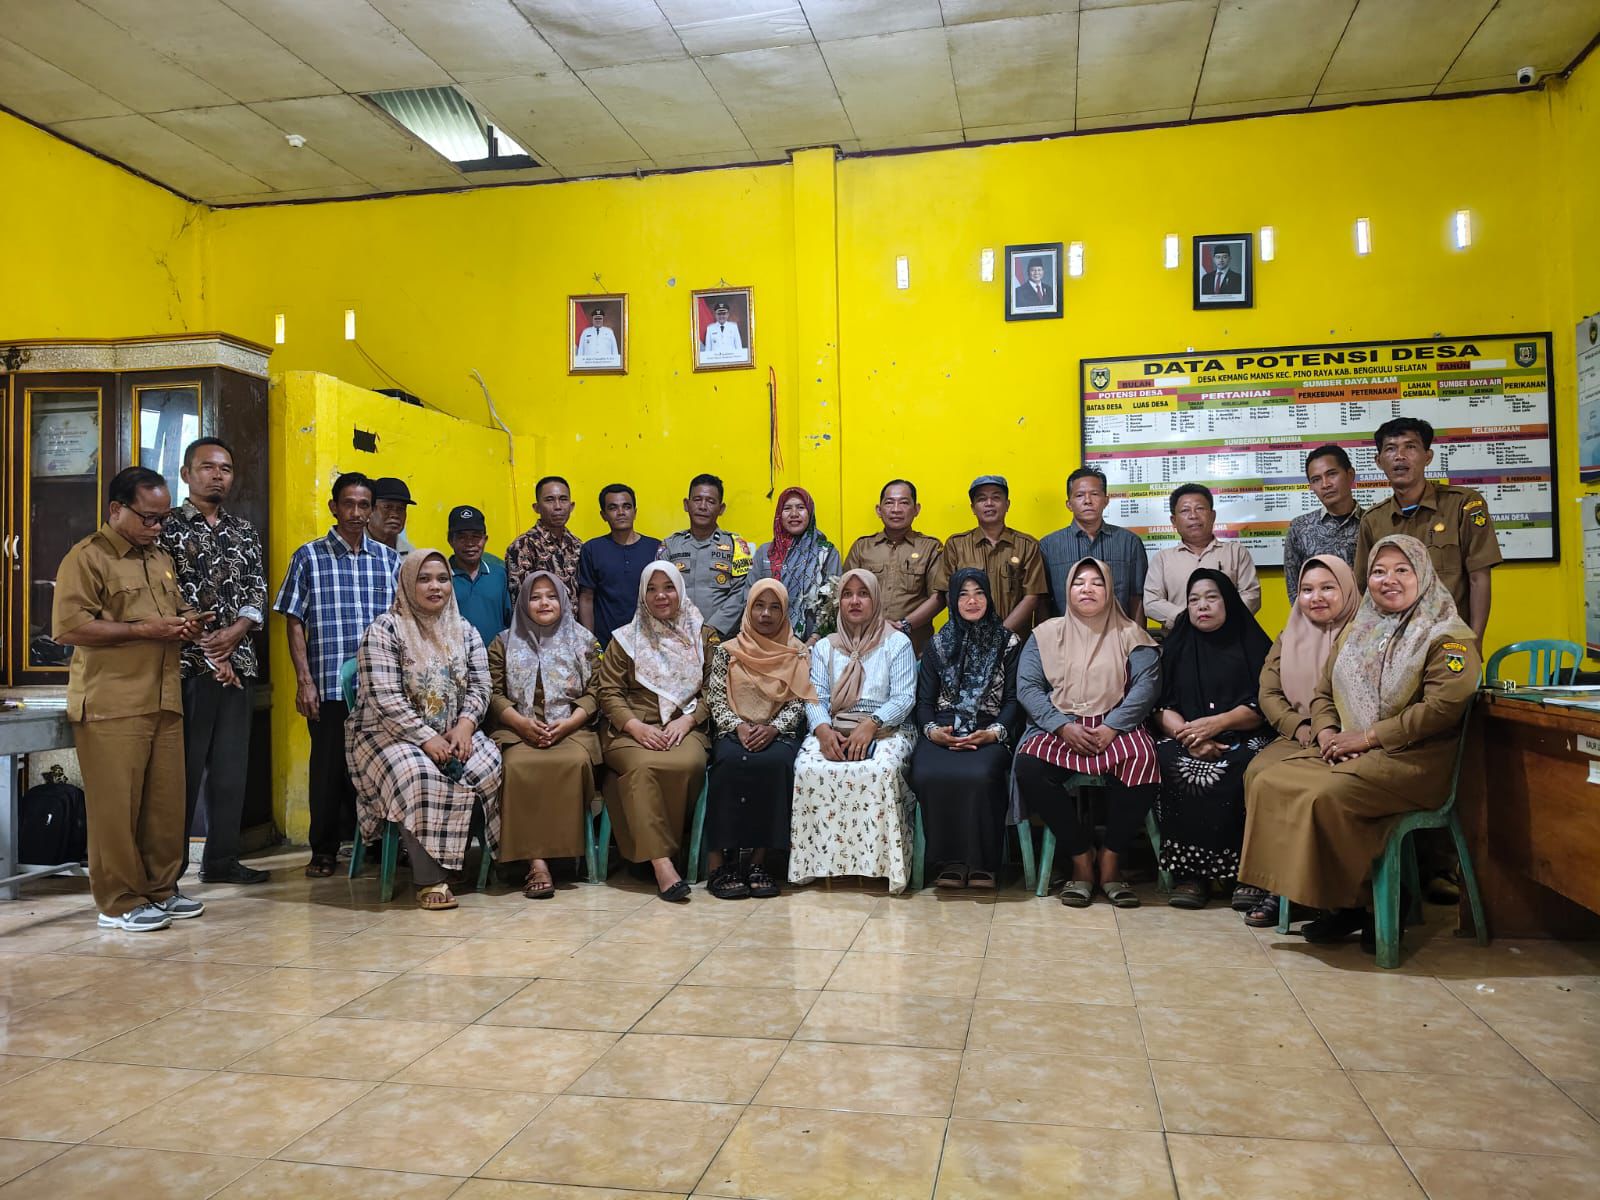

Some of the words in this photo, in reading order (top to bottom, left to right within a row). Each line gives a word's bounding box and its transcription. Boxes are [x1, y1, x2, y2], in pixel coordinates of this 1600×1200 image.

[1144, 359, 1225, 376] DATA
[1236, 350, 1378, 369] POTENSI
[1392, 344, 1481, 361] DESA
[1438, 361, 1470, 370] TAHUN
[1198, 375, 1217, 384] DESA
[1218, 373, 1248, 382] KEMANG
[1250, 372, 1274, 380] MANIS
[1275, 371, 1291, 379] KEC.
[1293, 370, 1312, 378] PINO
[1314, 369, 1333, 377] RAYA
[1334, 368, 1351, 376] KAB.
[1353, 364, 1393, 374] BENGKULU
[1394, 364, 1427, 373] SELATAN
[1122, 380, 1151, 389] BULAN
[1302, 379, 1342, 388] SUMBER
[1344, 378, 1368, 386] DAYA
[1370, 376, 1398, 385] ALAM
[1407, 382, 1431, 390] LAHAN
[1439, 380, 1469, 388] SUMBER
[1470, 378, 1488, 386] DAYA
[1490, 377, 1502, 385] AIR
[1504, 381, 1546, 390] PERIKANAN
[1139, 389, 1163, 397] DESA
[1201, 390, 1271, 400] PERTANIAN
[1298, 390, 1345, 399] PERKEBUNAN
[1351, 387, 1398, 396] PETERNAKAN
[1403, 389, 1436, 398] GEMBALA
[1133, 401, 1150, 409] LUAS
[1151, 400, 1169, 408] DESA
[1471, 425, 1521, 434] KELEMBAGAAN
[1359, 472, 1387, 481] SARANA
[1512, 513, 1530, 521] DESA
